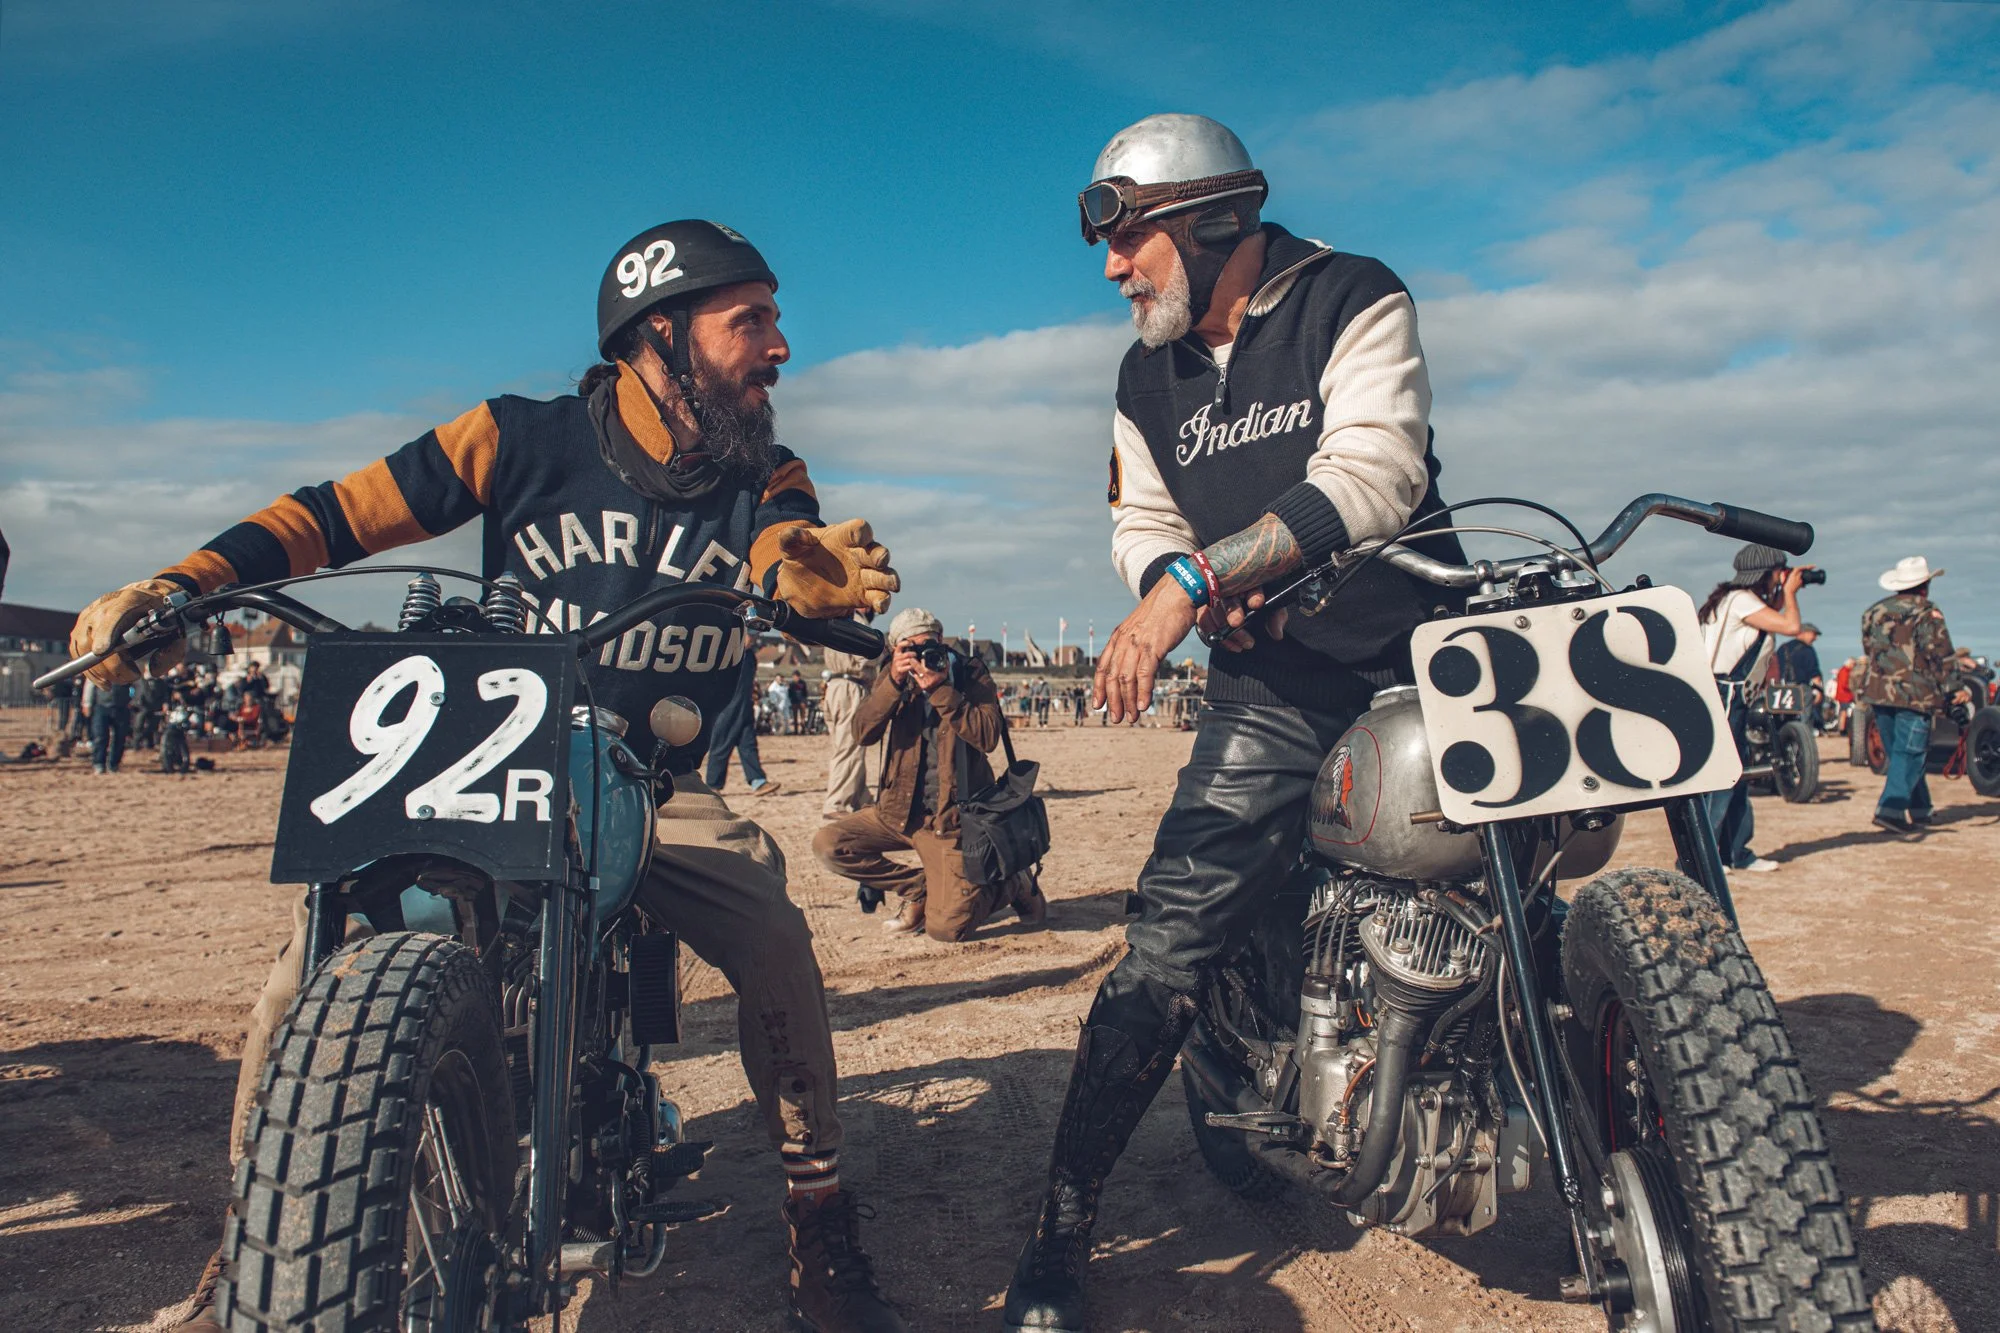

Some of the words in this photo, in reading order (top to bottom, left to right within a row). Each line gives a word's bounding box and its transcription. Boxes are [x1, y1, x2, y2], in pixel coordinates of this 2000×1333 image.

[616, 239, 684, 299] 92
[1176, 399, 1313, 467] Indian
[1428, 605, 1715, 809] 38
[1772, 688, 1795, 710] 14
